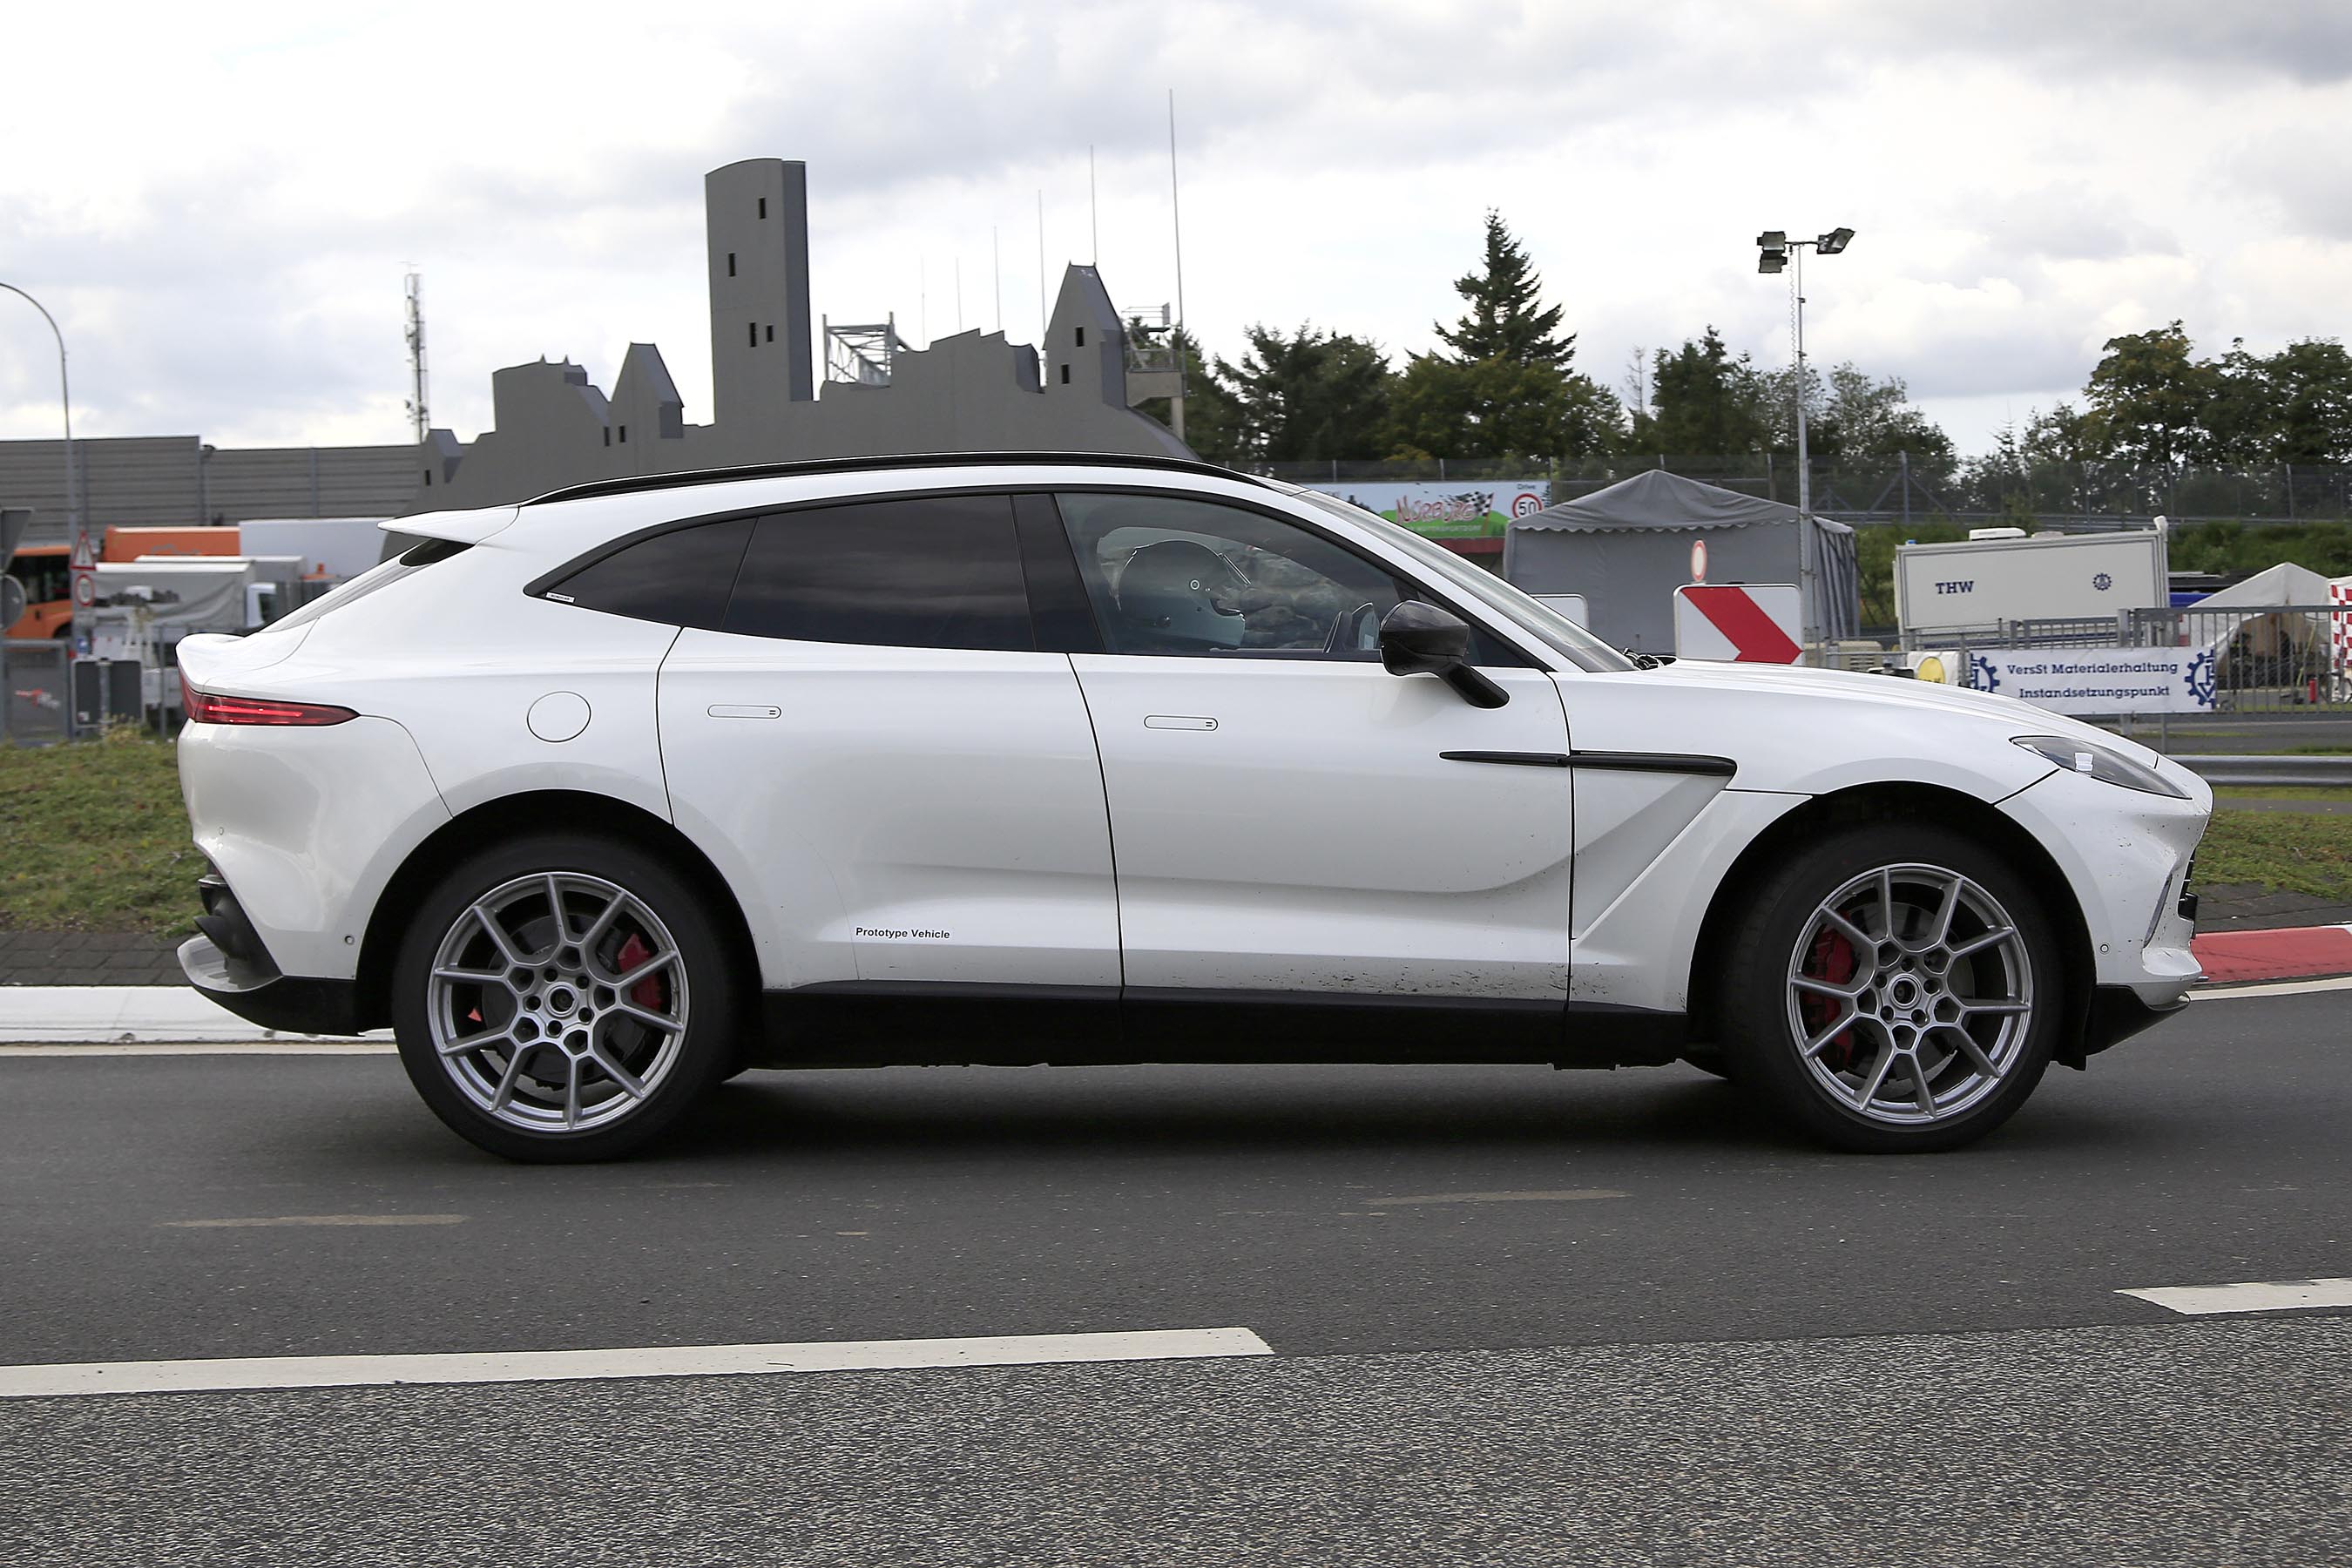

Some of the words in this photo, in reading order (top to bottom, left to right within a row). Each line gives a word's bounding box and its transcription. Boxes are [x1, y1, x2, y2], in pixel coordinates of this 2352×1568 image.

[1518, 501, 1537, 516] 50
[1935, 580, 1975, 594] THW
[2007, 665, 2048, 675] VersSt
[2051, 662, 2179, 674] Materialerhaltung
[2019, 686, 2171, 700] Instandsetzungspunkt
[855, 927, 908, 939] Prototype
[910, 929, 950, 939] Vehicle
